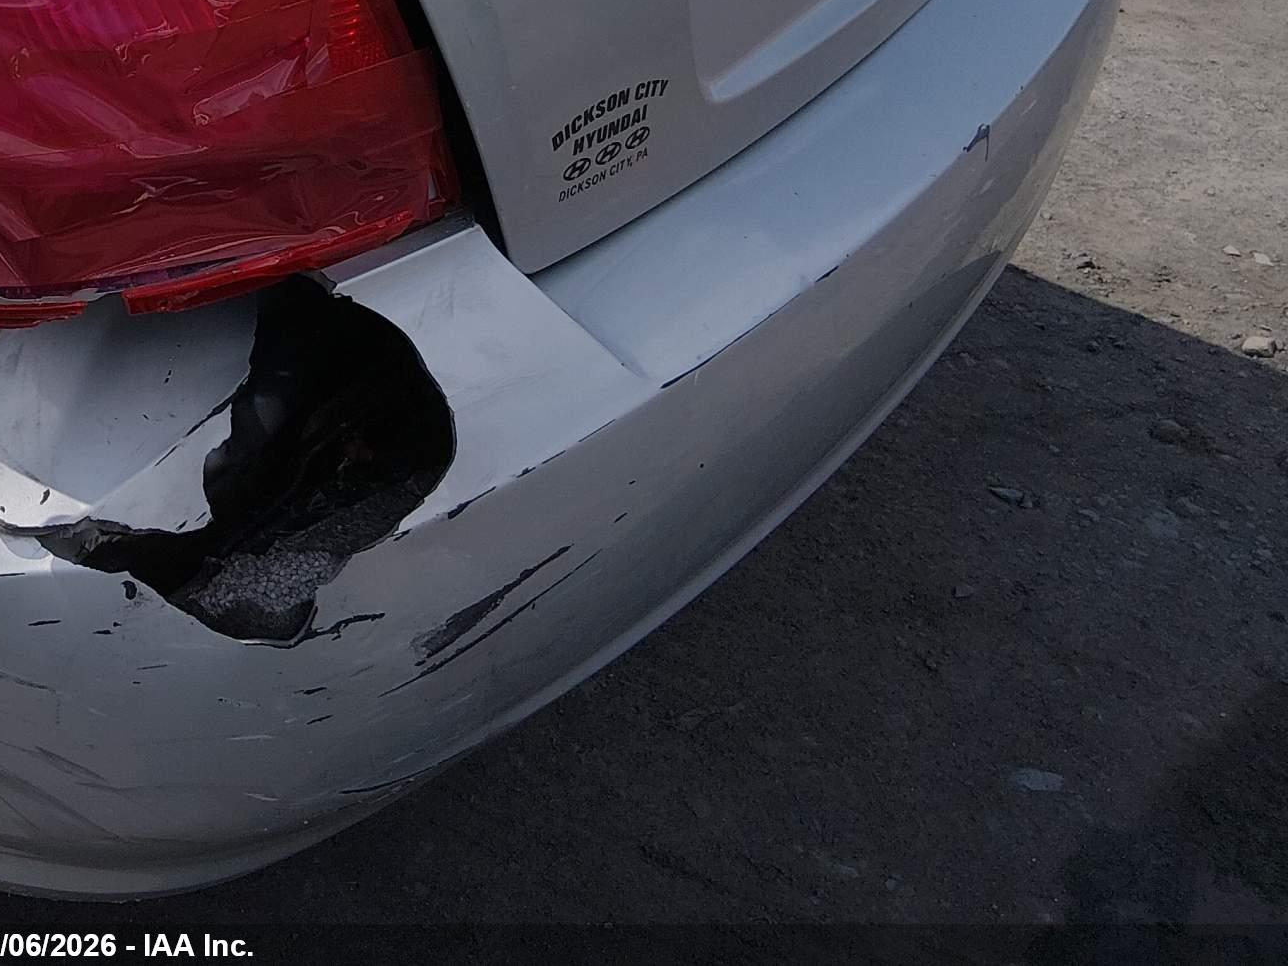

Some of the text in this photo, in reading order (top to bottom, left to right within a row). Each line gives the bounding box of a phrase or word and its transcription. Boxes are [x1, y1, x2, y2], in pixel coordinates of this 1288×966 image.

[551, 79, 669, 152] DICKSON CITY
[572, 104, 648, 156] HYUNDAI
[559, 147, 648, 202] DICKSON CITY, PA
